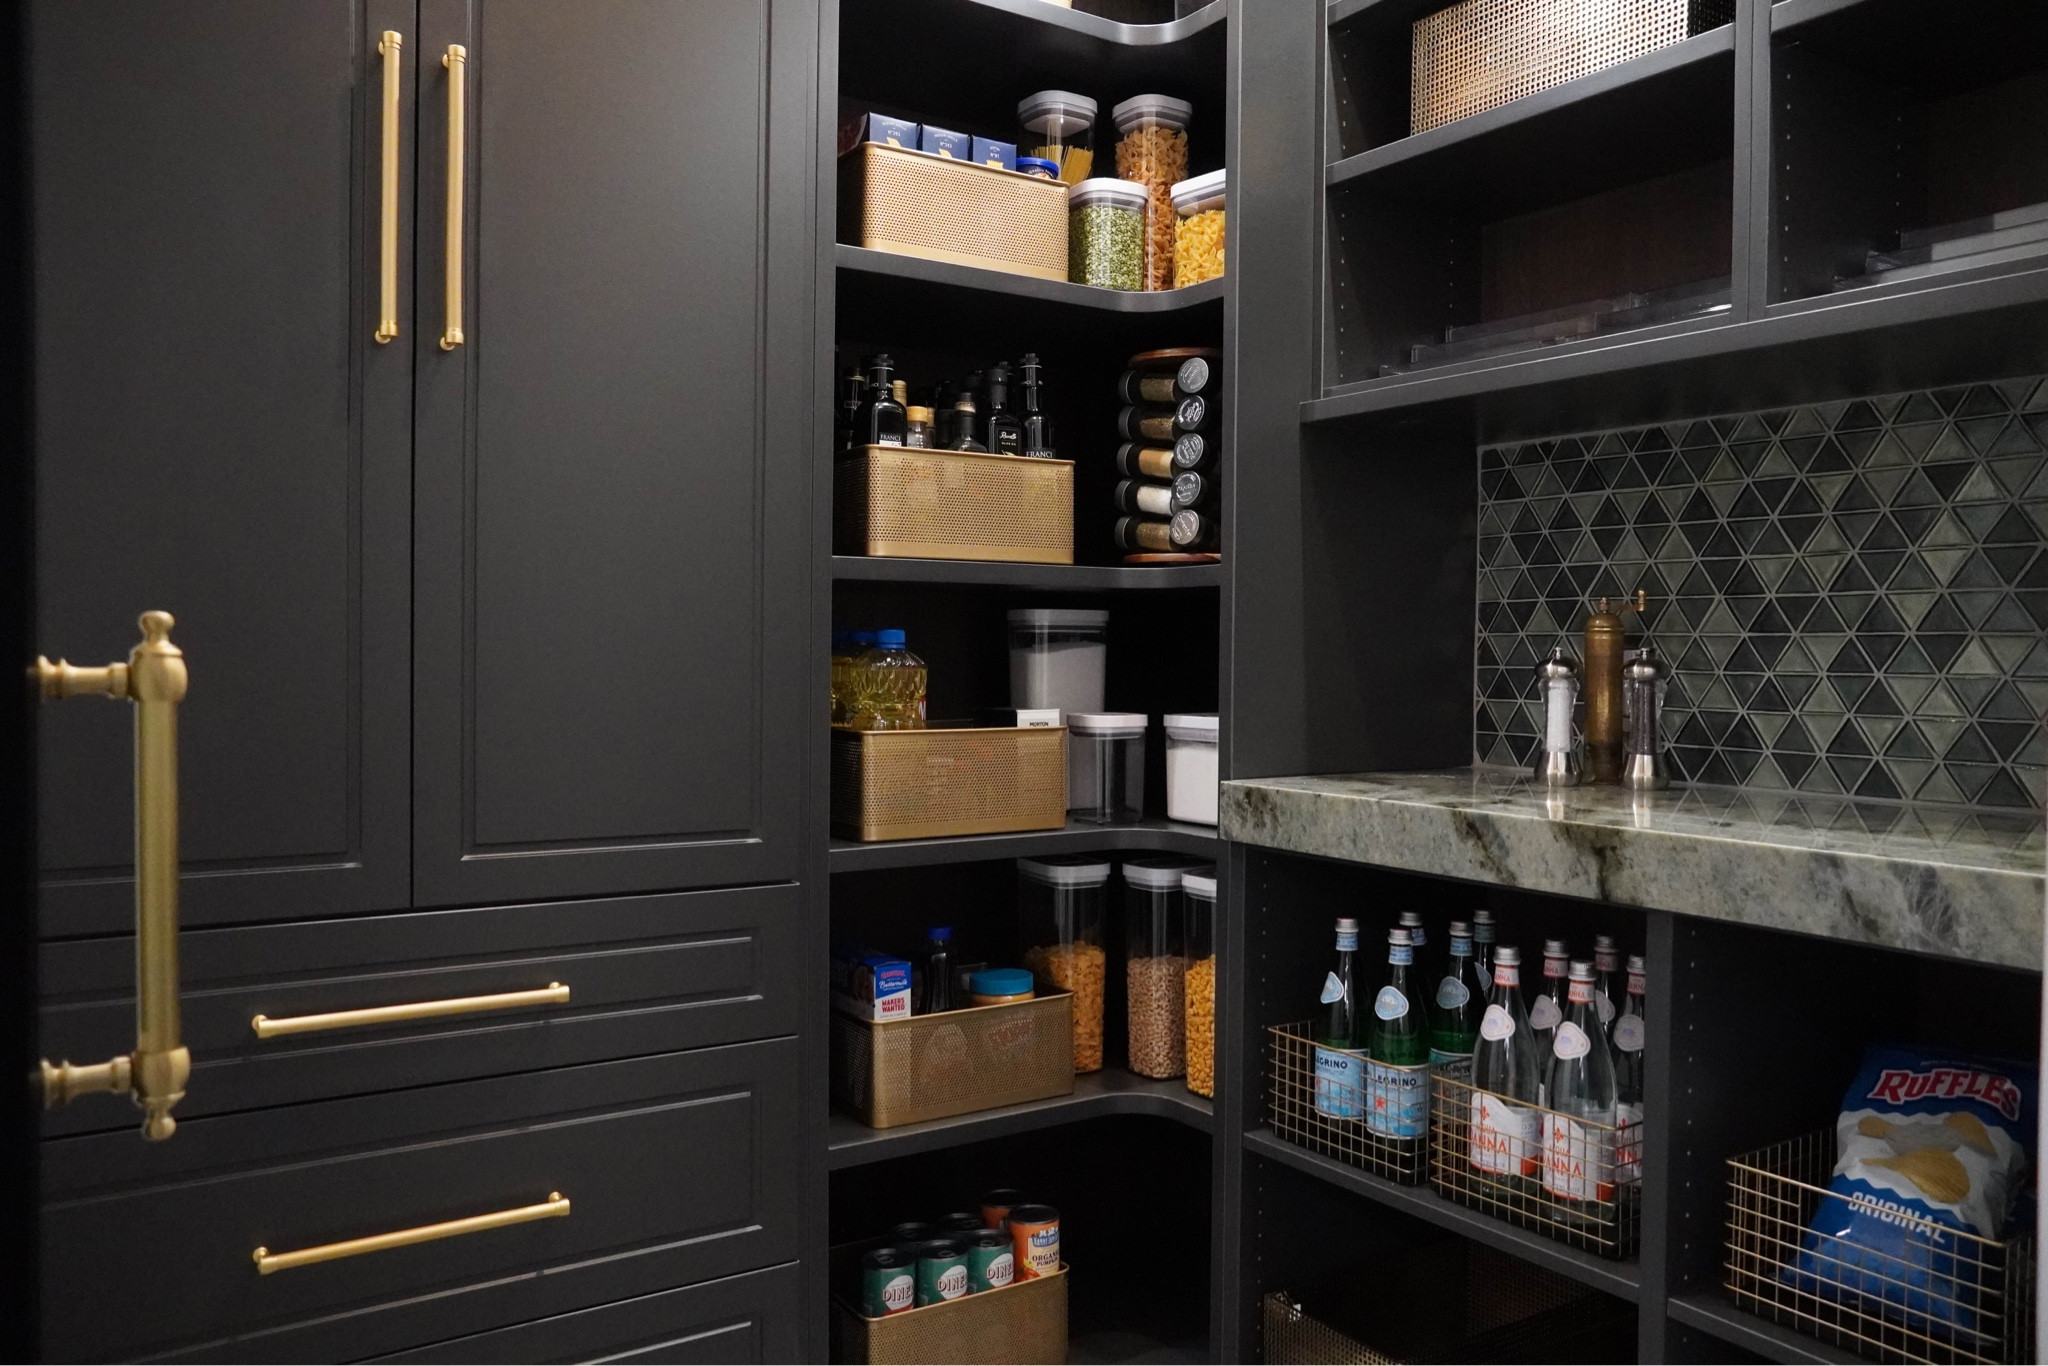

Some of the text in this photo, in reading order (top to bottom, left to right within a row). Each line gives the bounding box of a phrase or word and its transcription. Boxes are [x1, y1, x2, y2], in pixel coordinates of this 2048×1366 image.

[1866, 1068, 2021, 1121] RUFFLES
[1847, 1191, 1946, 1244] ORIGINAL
[938, 1276, 967, 1291] DINE
[987, 1263, 1014, 1280] DINE
